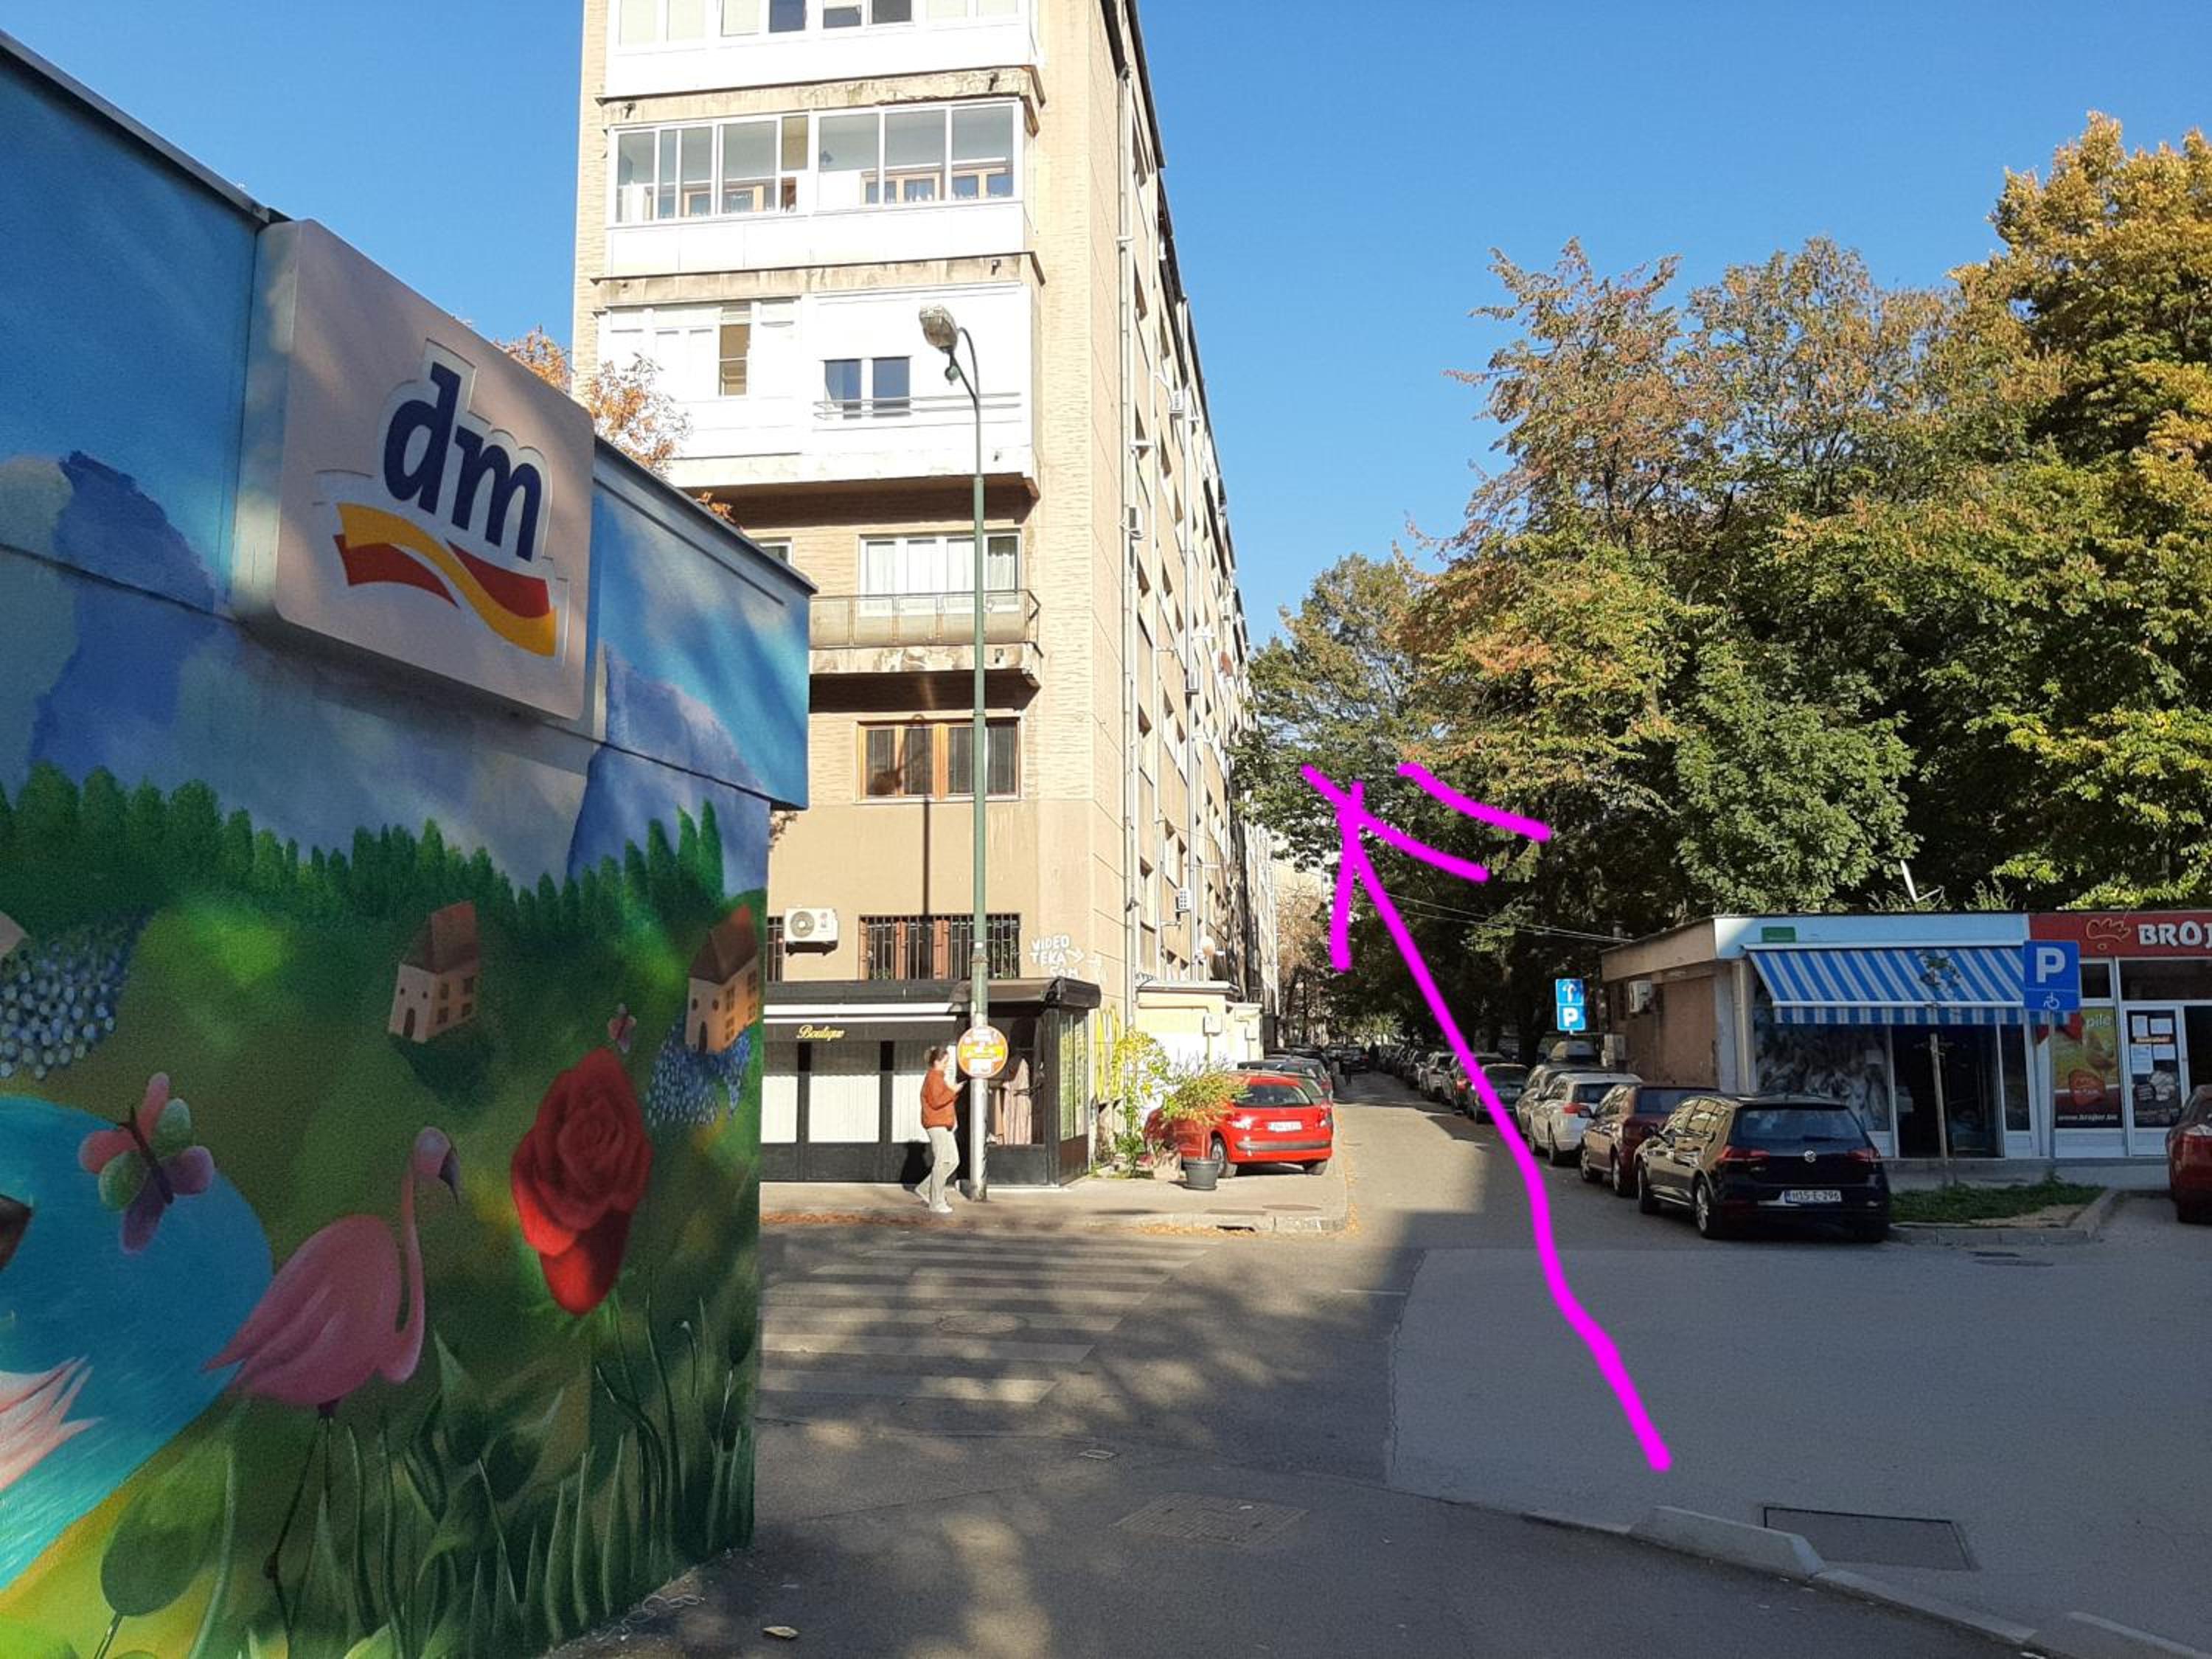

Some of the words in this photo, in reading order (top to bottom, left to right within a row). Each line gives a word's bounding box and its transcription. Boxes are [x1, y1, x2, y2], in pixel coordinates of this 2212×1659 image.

[383, 362, 543, 563] dm
[1031, 934, 1070, 951] VIDEO
[1029, 950, 1066, 968] TEKA
[2036, 947, 2065, 983] P
[1563, 1007, 1579, 1027] P
[796, 1024, 845, 1041] Boutique
